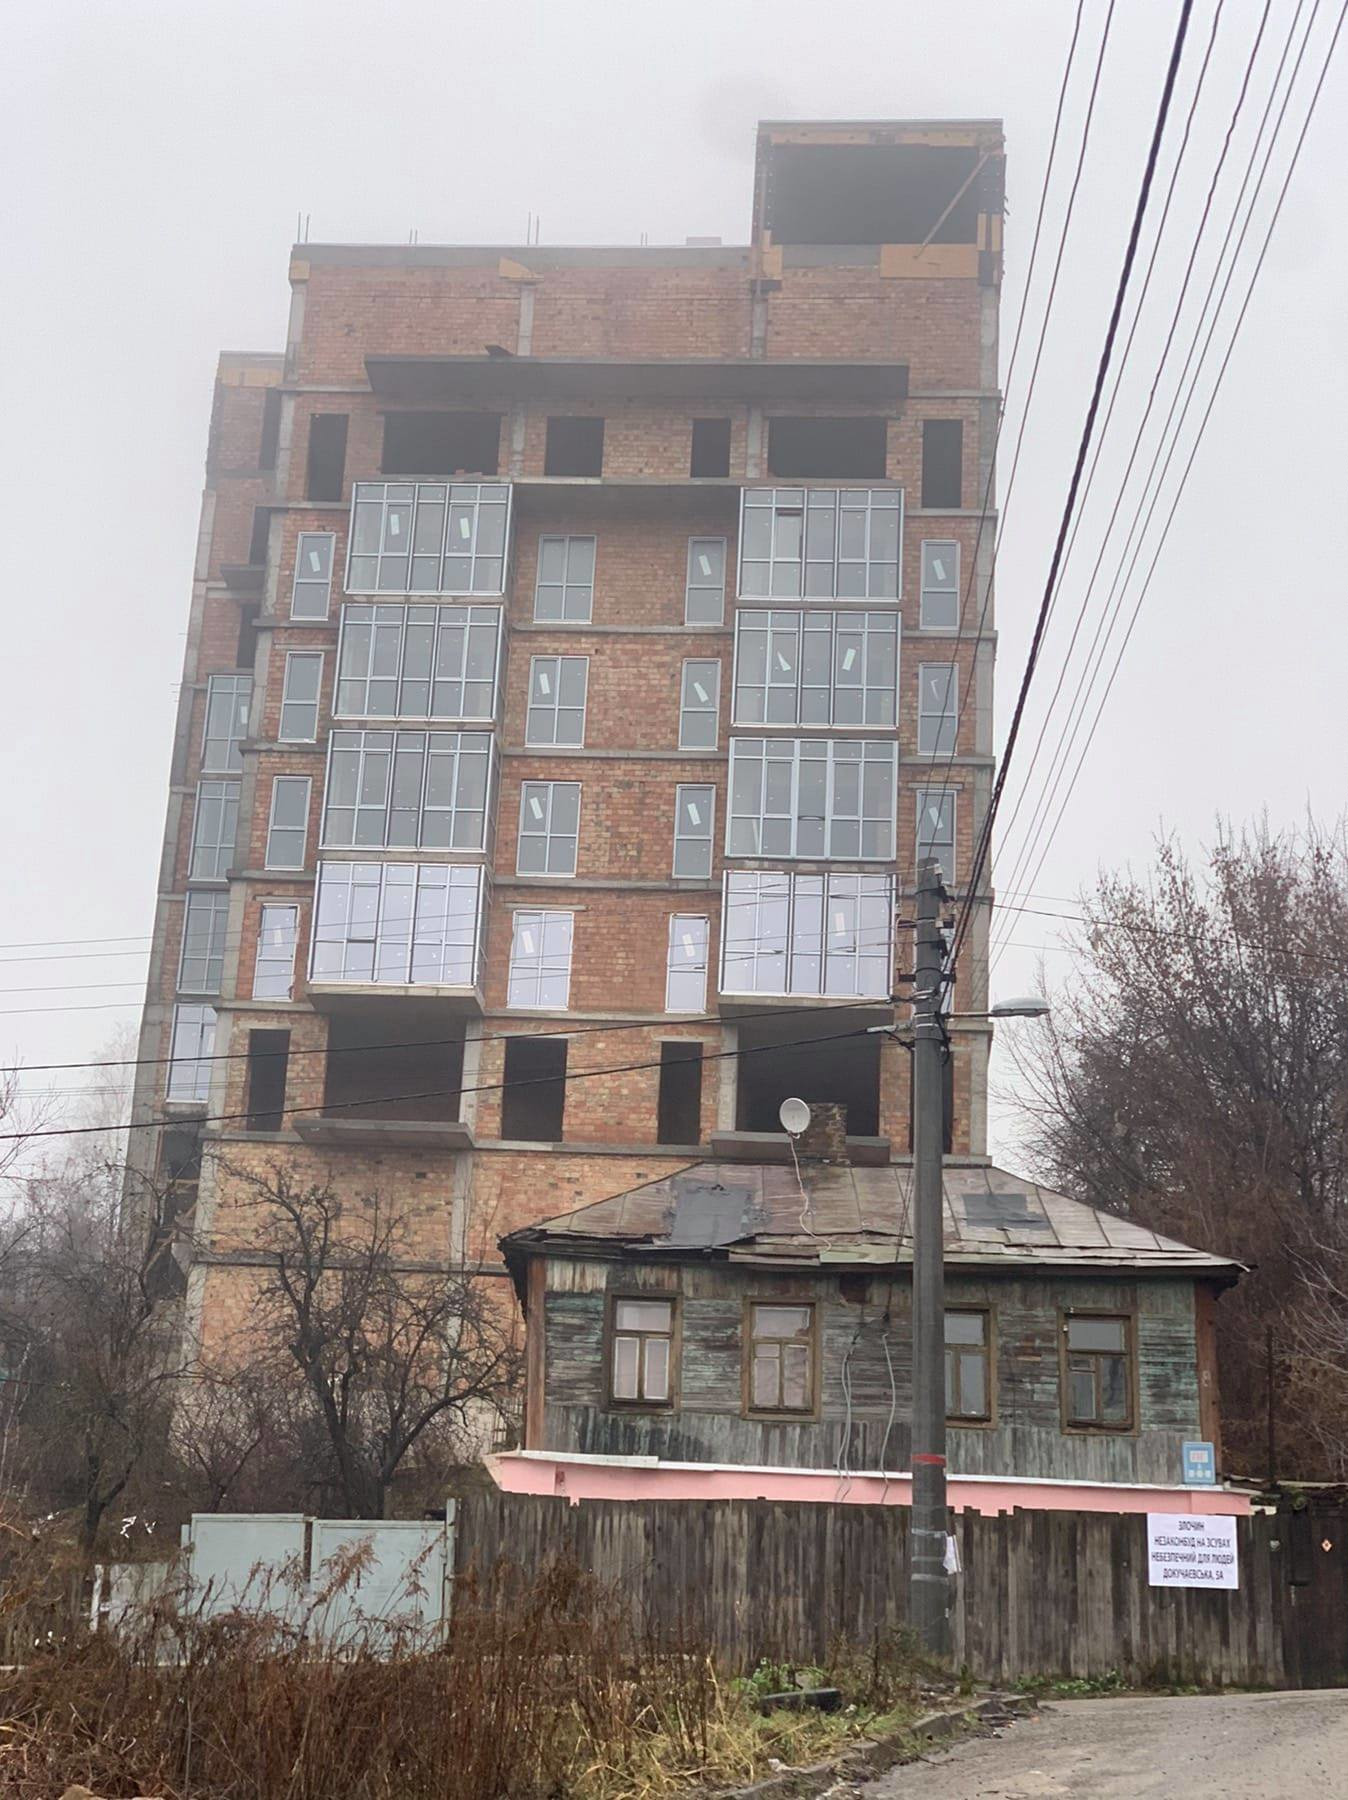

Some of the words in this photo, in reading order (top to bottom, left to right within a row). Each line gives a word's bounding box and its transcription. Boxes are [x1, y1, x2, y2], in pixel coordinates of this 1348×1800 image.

[1178, 1520, 1205, 1531] ЗЛОЧИН
[1154, 1536, 1196, 1549] НЕЗАКОНБУД
[1196, 1537, 1206, 1548] НА
[1206, 1537, 1231, 1548] ЗСУВАХ
[1151, 1551, 1197, 1564] НЕБЕЗПЕЧНИЙ
[1197, 1553, 1210, 1565] ДЛЯ
[1211, 1551, 1234, 1566] ЛЮДЕЙ
